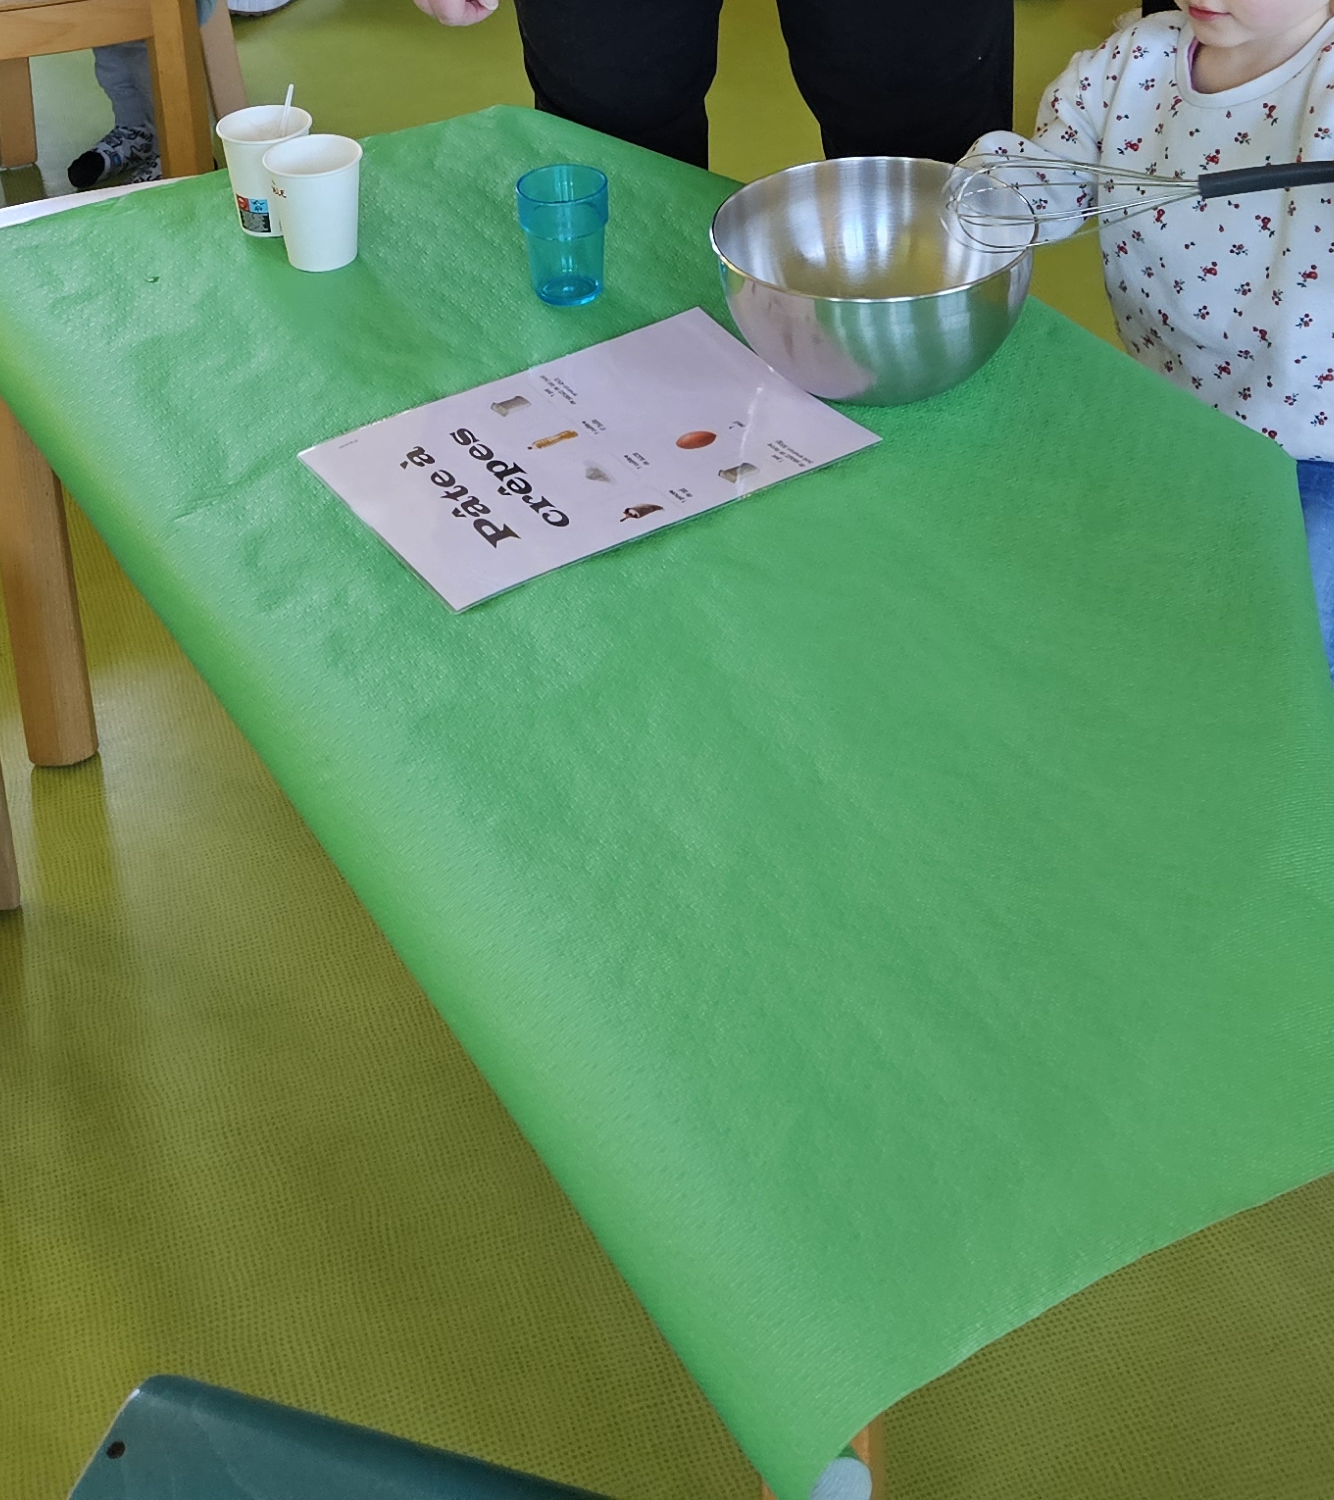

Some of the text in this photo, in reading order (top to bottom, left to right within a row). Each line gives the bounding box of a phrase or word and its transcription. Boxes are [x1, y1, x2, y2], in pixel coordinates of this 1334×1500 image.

[399, 446, 521, 549] Pâte à
[449, 428, 570, 527] crêpes
